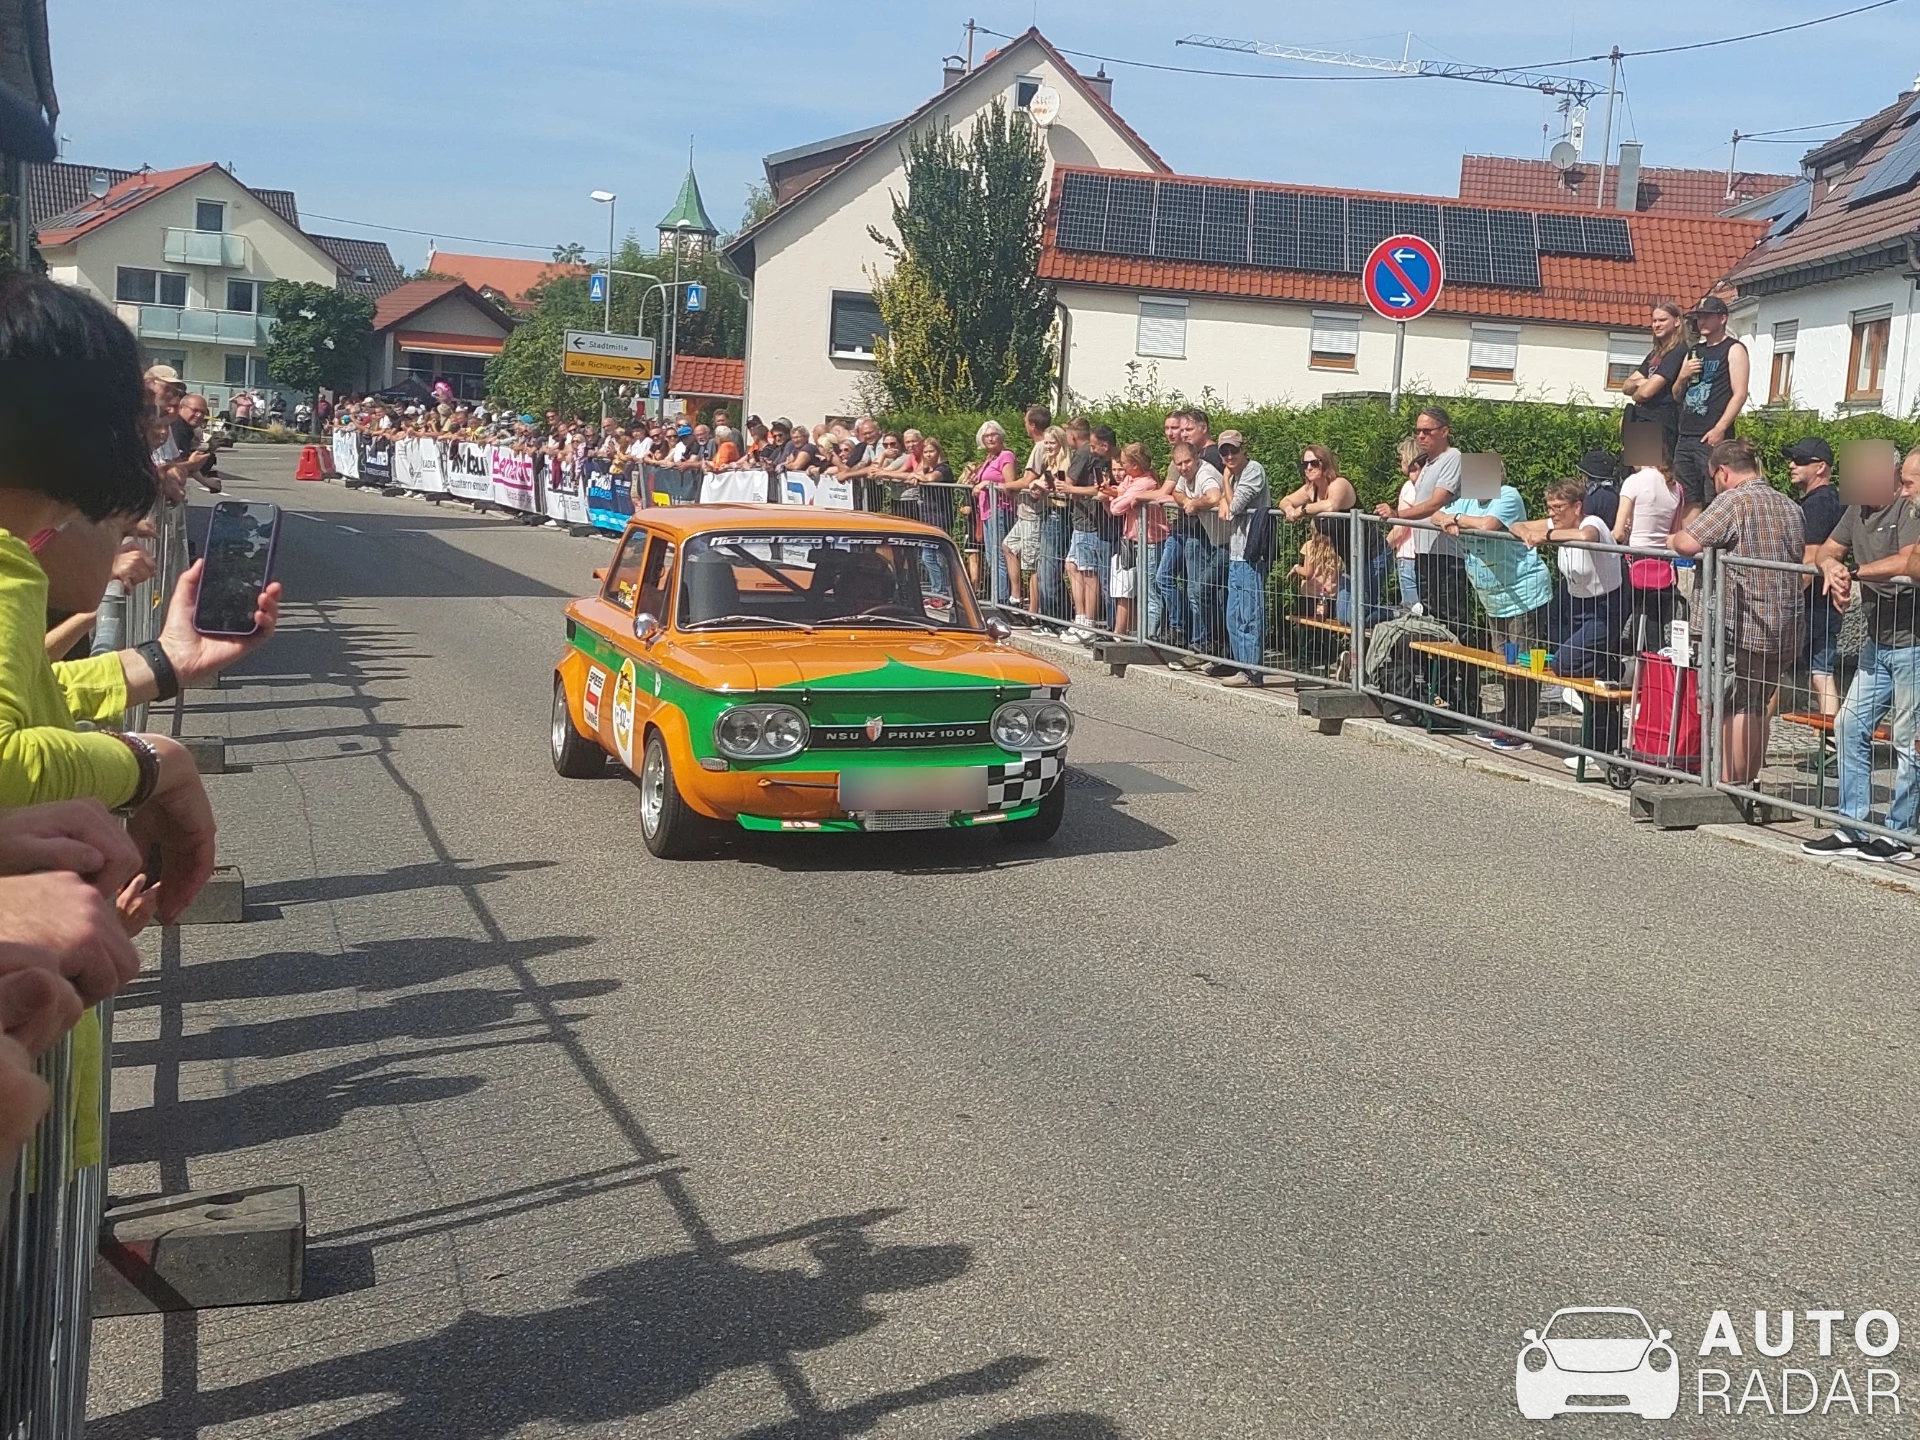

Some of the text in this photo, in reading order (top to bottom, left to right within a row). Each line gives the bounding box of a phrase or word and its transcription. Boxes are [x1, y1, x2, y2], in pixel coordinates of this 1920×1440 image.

[588, 340, 629, 352] Stadtmitte
[570, 359, 631, 372] alle Richtungen
[837, 535, 885, 545] Corse
[826, 729, 976, 740] NSU PRINZ 1000
